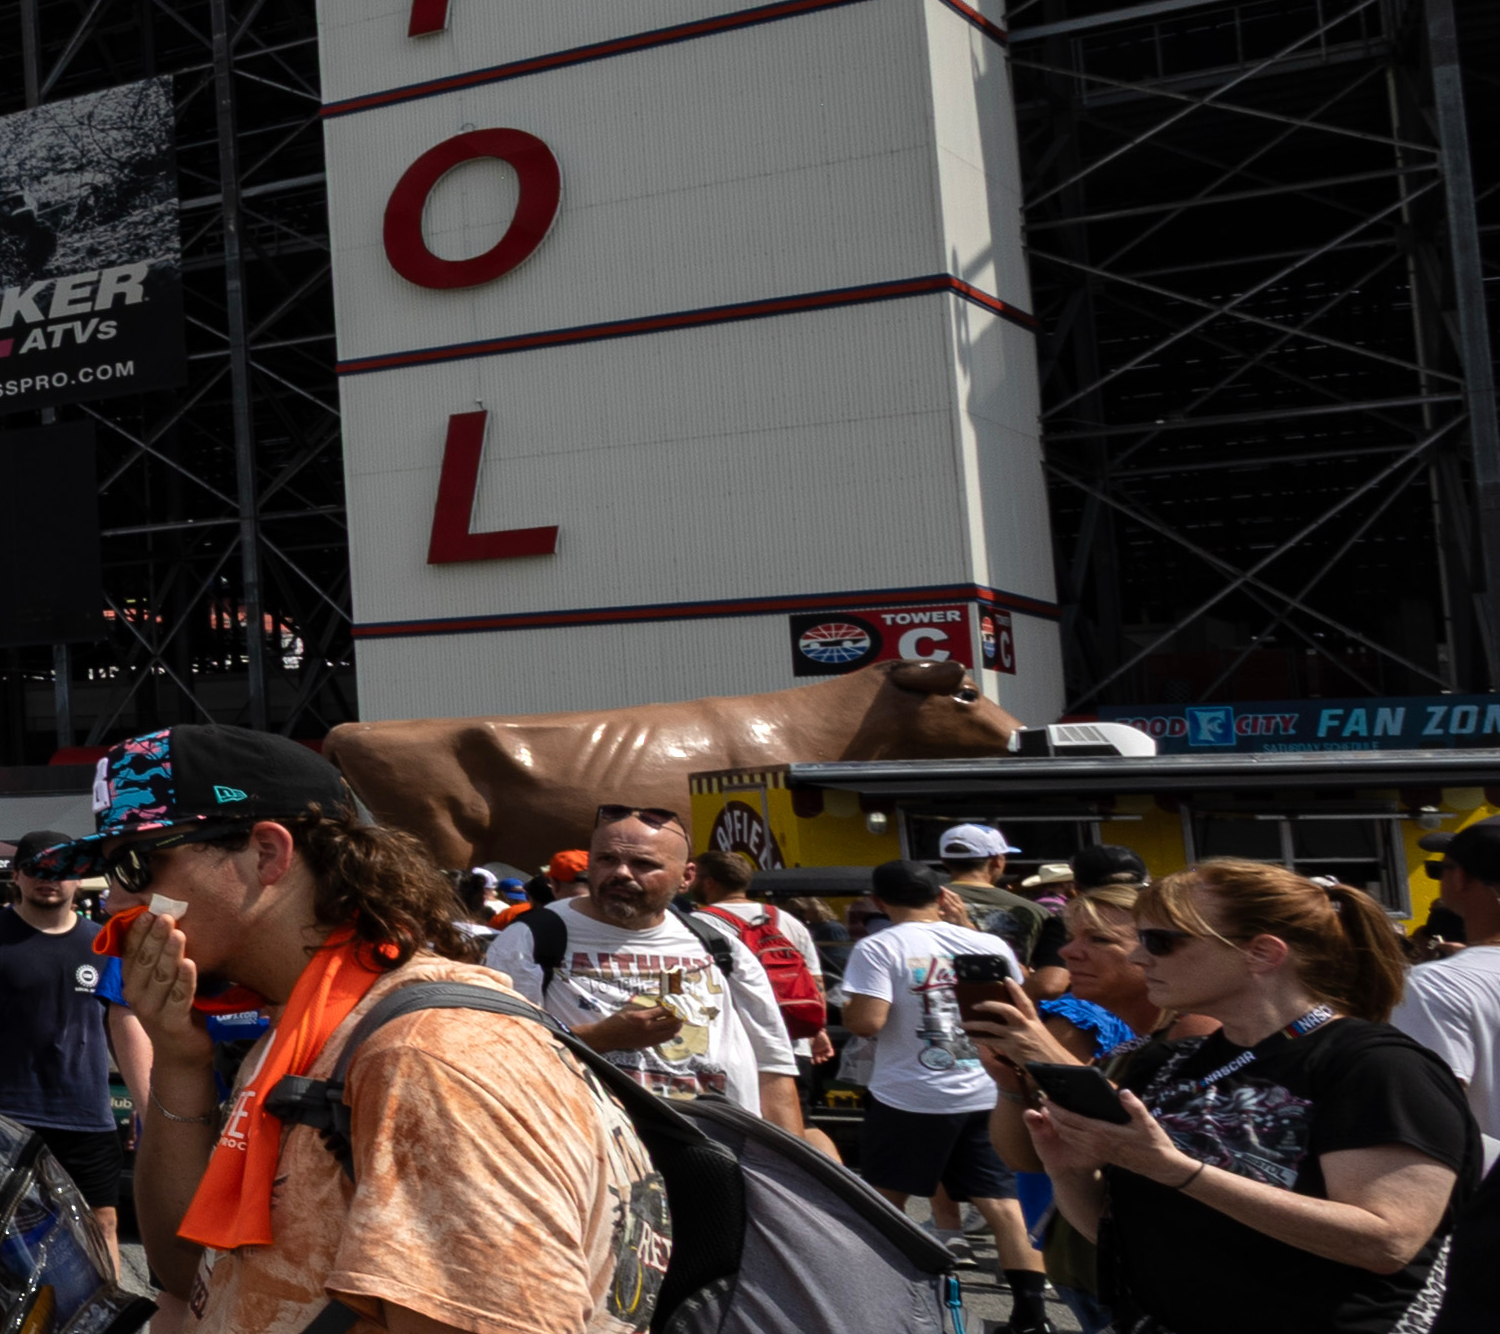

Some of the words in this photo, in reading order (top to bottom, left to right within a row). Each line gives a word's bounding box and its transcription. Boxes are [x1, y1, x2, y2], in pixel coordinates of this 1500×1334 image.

[18, 320, 118, 355] ATVs
[881, 609, 961, 625] TOWER
[900, 627, 954, 665] C
[1235, 713, 1299, 736] CITY
[1317, 707, 1406, 738] FAN
[1421, 704, 1500, 736] ZON
[1204, 1050, 1257, 1085] NASCAR
